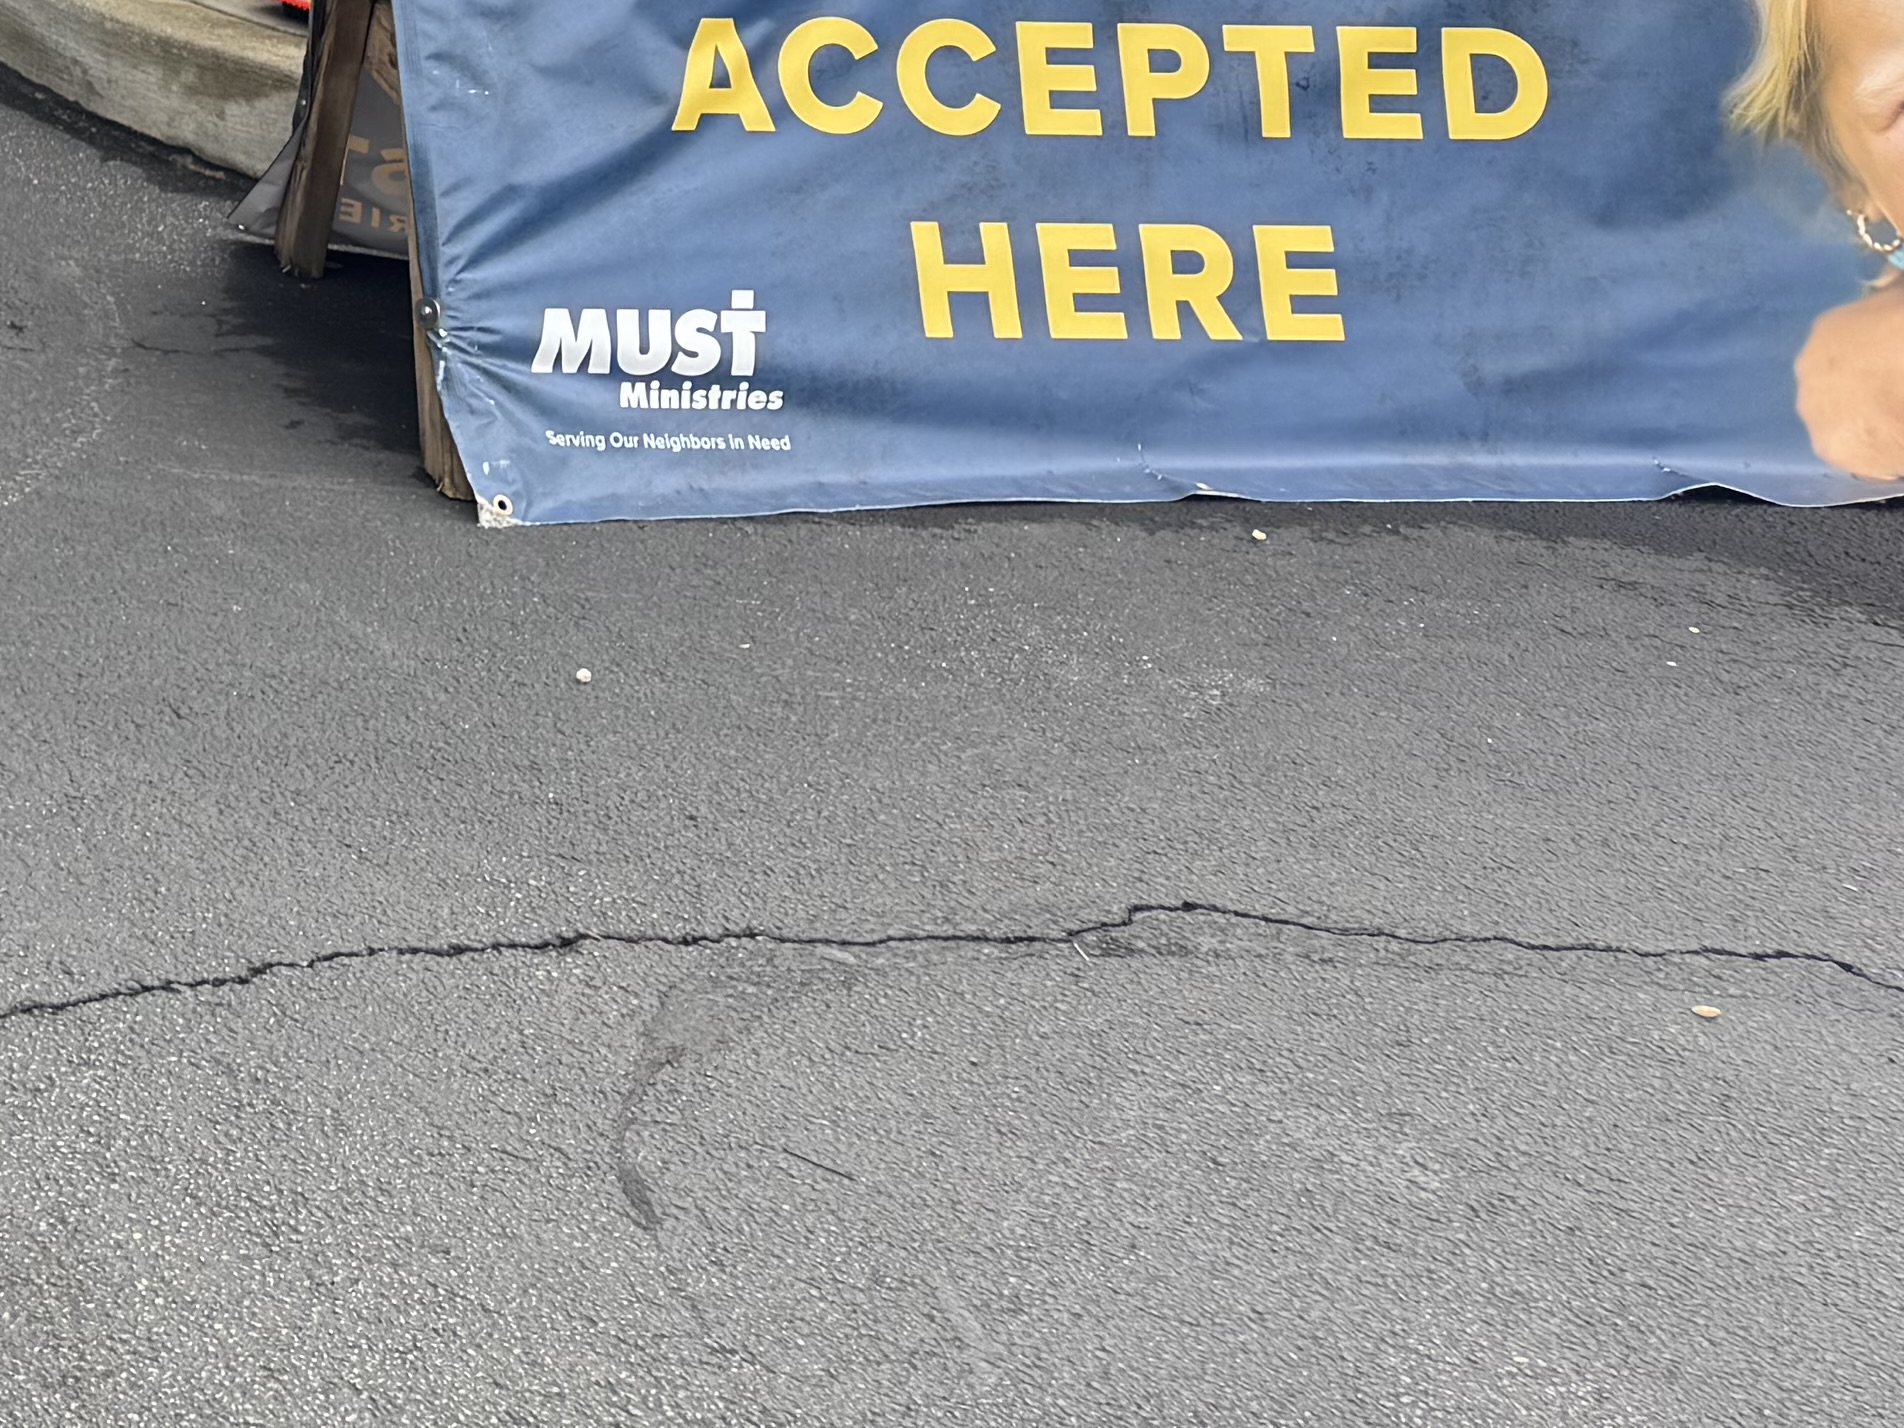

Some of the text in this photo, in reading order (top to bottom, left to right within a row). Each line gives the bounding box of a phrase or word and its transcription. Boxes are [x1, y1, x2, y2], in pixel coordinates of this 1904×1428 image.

[671, 16, 1549, 141] ACCEPTED
[909, 220, 1345, 342] HERE
[531, 289, 766, 376] MUST
[620, 380, 783, 410] Ministries
[546, 430, 606, 451] Serving
[610, 432, 639, 448] Our
[643, 434, 725, 452] Neighbors
[748, 435, 791, 450] Need
